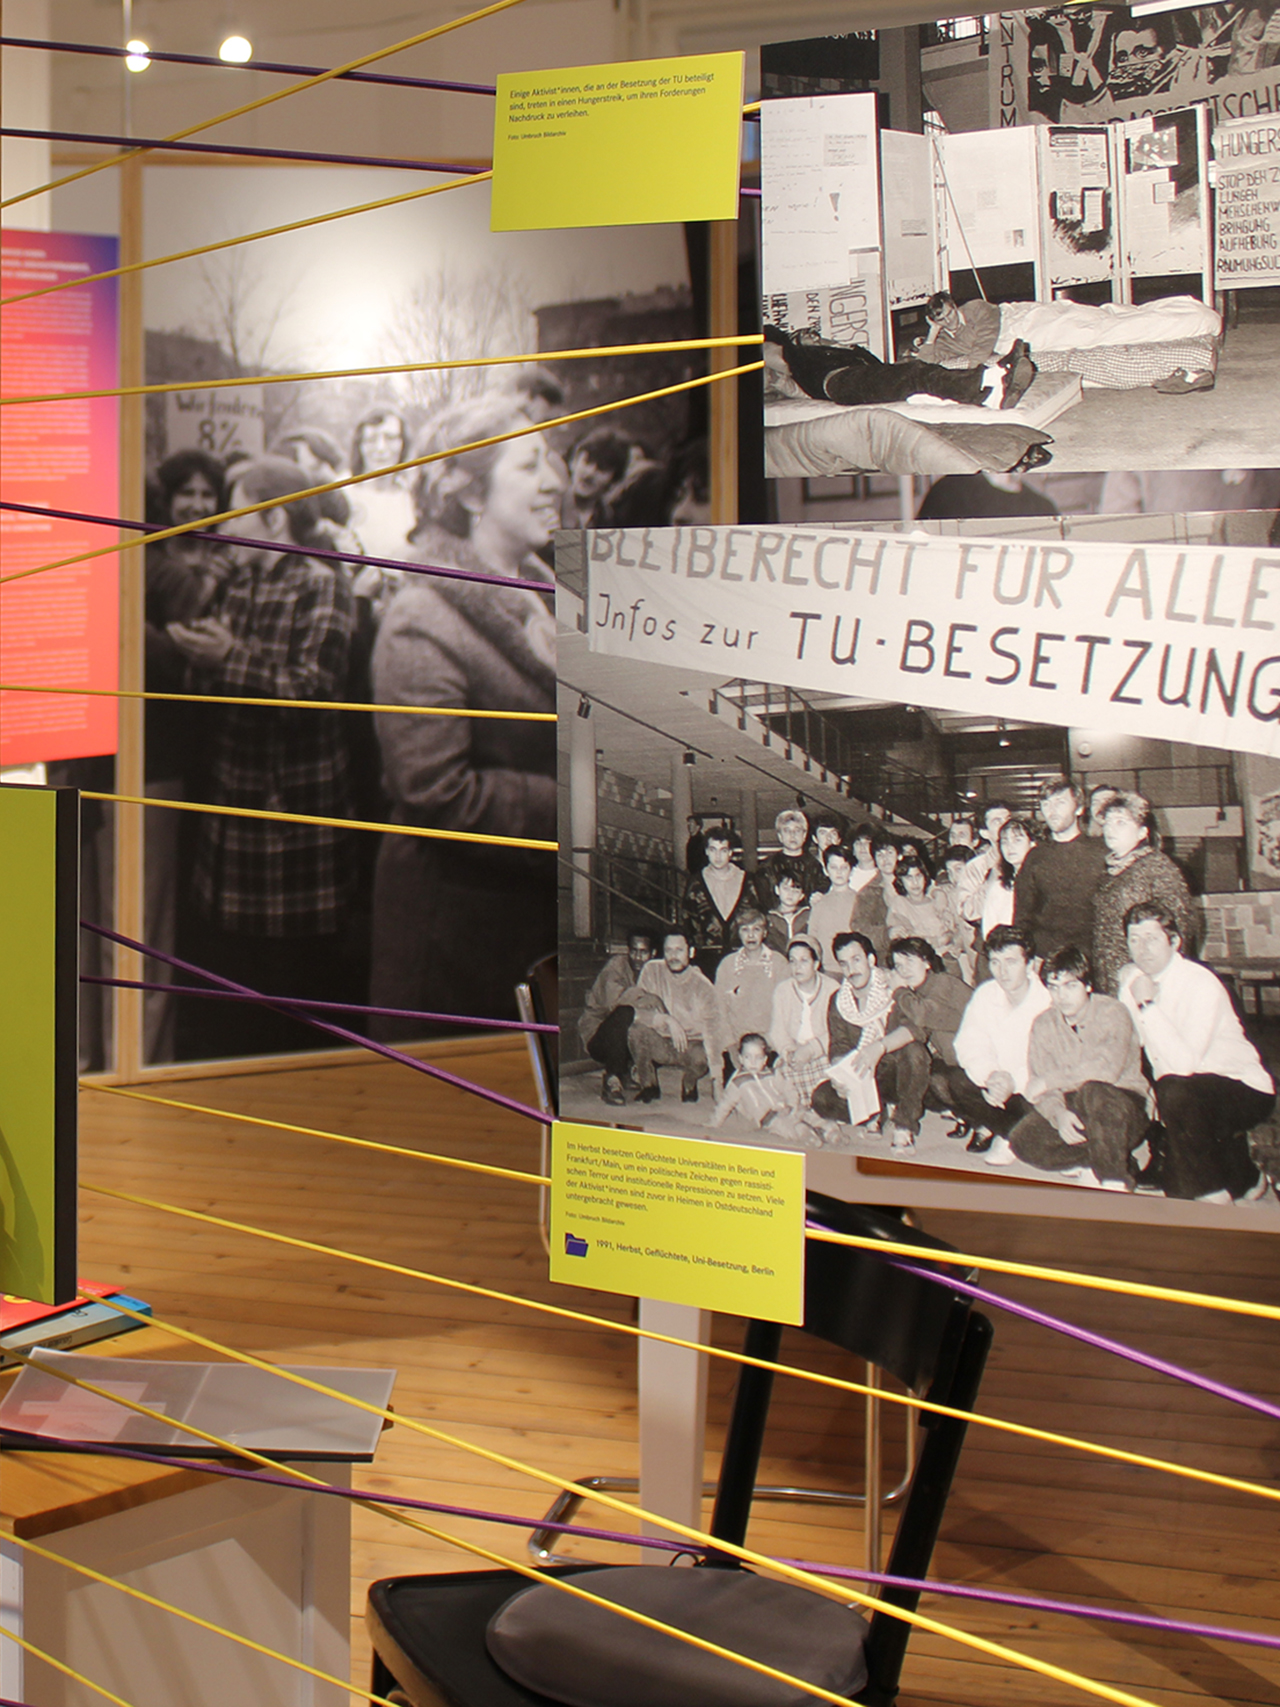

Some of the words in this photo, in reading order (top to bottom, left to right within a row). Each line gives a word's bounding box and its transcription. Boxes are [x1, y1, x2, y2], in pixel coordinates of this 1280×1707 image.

[999, 14, 1017, 127] NTRUM
[510, 90, 530, 99] Einige
[583, 84, 594, 92] die
[620, 79, 657, 88] Besetzung
[659, 77, 671, 85] der
[673, 75, 683, 83] TU
[685, 73, 714, 82] beteiligt
[510, 102, 525, 110] sind,
[527, 100, 547, 109] treten
[549, 99, 555, 107] in
[578, 94, 624, 105] Hungerstreik,
[640, 91, 658, 99] ihren
[660, 87, 706, 97] Forderungen
[509, 113, 544, 122] Nachdruck
[557, 110, 589, 119] verleihen.
[1218, 173, 1244, 190] STOP
[1247, 170, 1267, 187] DEN
[1220, 189, 1258, 204] LUNGEN
[1220, 218, 1270, 236] BRINGUNG
[1219, 234, 1278, 252] AUFHEBUNG
[591, 527, 929, 596] BLEIBERECHT
[955, 544, 1074, 610] FÜR
[1104, 547, 1280, 631] ALLE
[700, 622, 758, 650] zur
[566, 1141, 576, 1150] Im
[577, 1143, 600, 1154] Herbst
[602, 1147, 634, 1158] besetzen
[635, 1151, 676, 1164] Geflüchtete
[678, 1157, 726, 1171] Universitäten
[728, 1164, 735, 1172] in
[737, 1165, 759, 1175] Berlin
[760, 1170, 775, 1178] und
[566, 1154, 622, 1170] Frankfurt/Main,
[623, 1163, 635, 1171] um
[649, 1166, 688, 1179] politisches
[689, 1171, 718, 1183] Zeichen
[720, 1177, 742, 1187] gegen
[744, 1180, 774, 1191] rassisti-
[566, 1167, 587, 1176] schen
[588, 1169, 609, 1180] Terror
[610, 1174, 624, 1183] und
[626, 1175, 673, 1190] institutionelle
[675, 1182, 725, 1197] Repressionen
[727, 1191, 735, 1199] zu
[737, 1193, 763, 1203] setzen.
[766, 1195, 785, 1206] Viele
[566, 1179, 578, 1187] der
[630, 1189, 645, 1198] sind
[646, 1192, 666, 1201] zuvor
[668, 1194, 674, 1202] in
[676, 1195, 704, 1207] Heimen
[706, 1200, 713, 1208] in
[714, 1201, 773, 1217] Ostdeutschland
[566, 1192, 614, 1206] untergebracht
[616, 1200, 648, 1211] gewesen.
[596, 1240, 615, 1251] 1991,
[616, 1243, 643, 1256] Herbst,
[645, 1247, 690, 1264] Geflüchtete,
[692, 1255, 749, 1274] Uni-Besetzung,
[751, 1264, 775, 1276] Berlin
